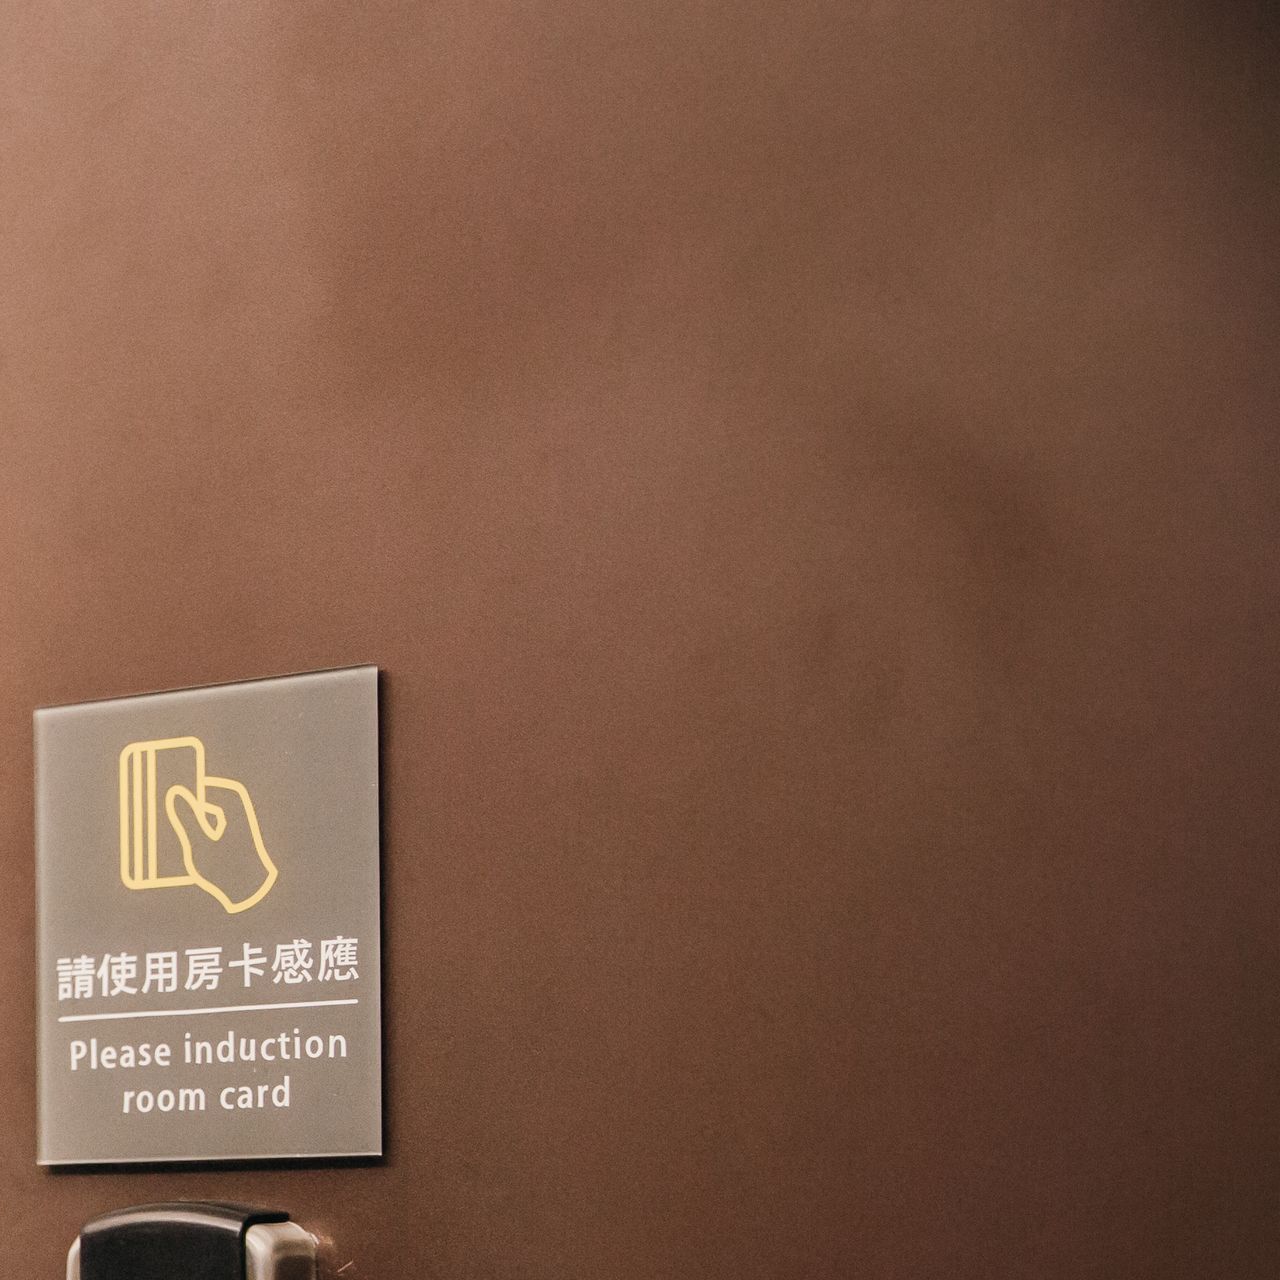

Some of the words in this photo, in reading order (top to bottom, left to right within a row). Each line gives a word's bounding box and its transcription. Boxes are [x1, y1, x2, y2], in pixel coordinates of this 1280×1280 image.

[55, 934, 360, 1001] 請使用房卡感應
[69, 1038, 172, 1071] Please
[184, 1027, 348, 1064] induction
[122, 1088, 207, 1114] room
[219, 1075, 291, 1110] card
